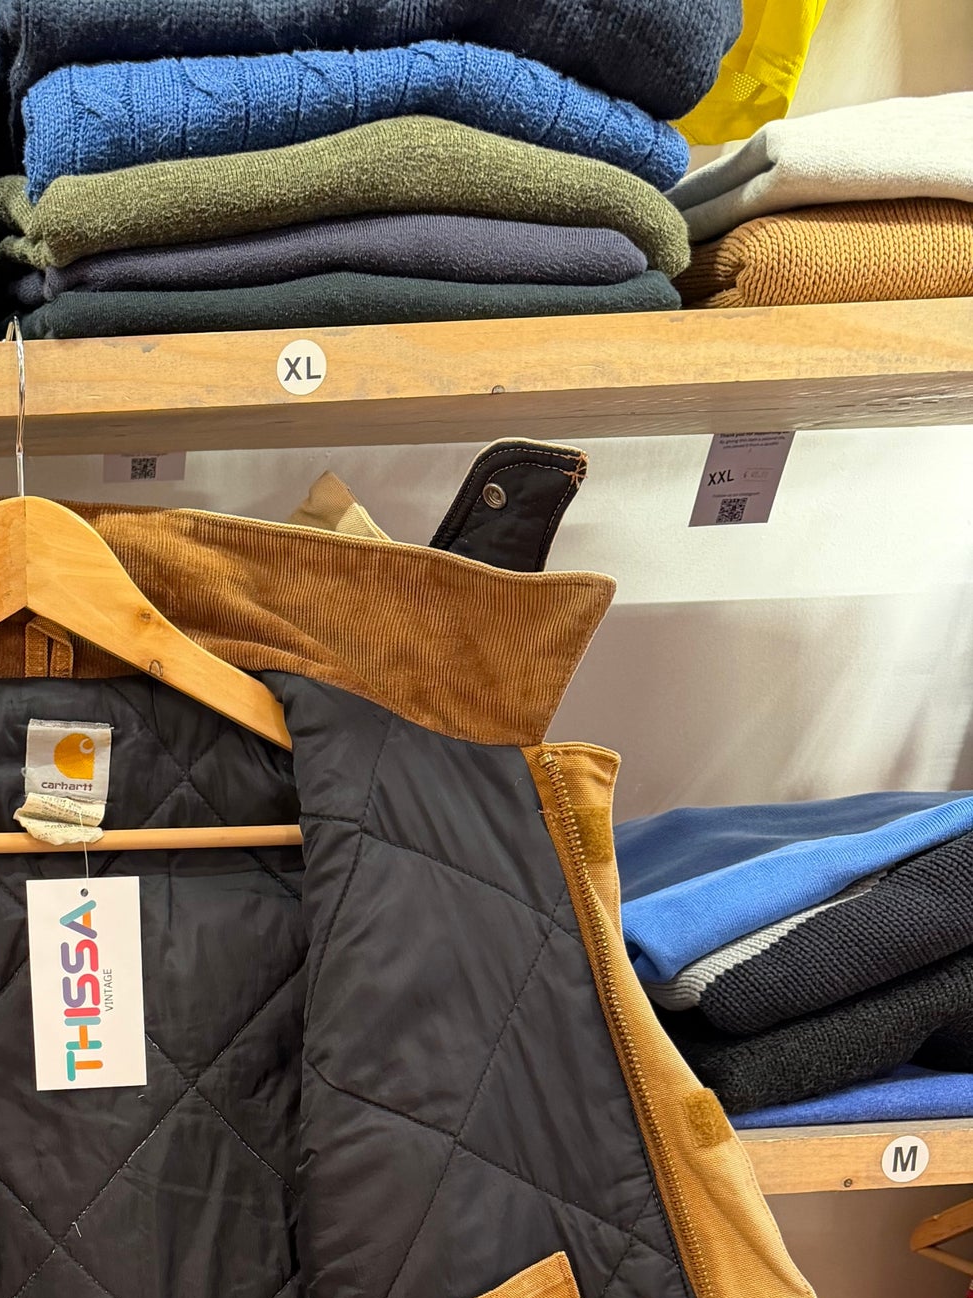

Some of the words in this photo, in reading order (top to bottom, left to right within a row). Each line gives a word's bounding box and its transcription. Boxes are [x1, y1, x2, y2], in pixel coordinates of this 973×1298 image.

[284, 356, 321, 381] XL
[707, 469, 734, 486] XXL
[41, 781, 93, 792] carhartt
[59, 900, 103, 1082] THISSA
[103, 968, 114, 1012] VINTAGE
[892, 1145, 918, 1172] M
